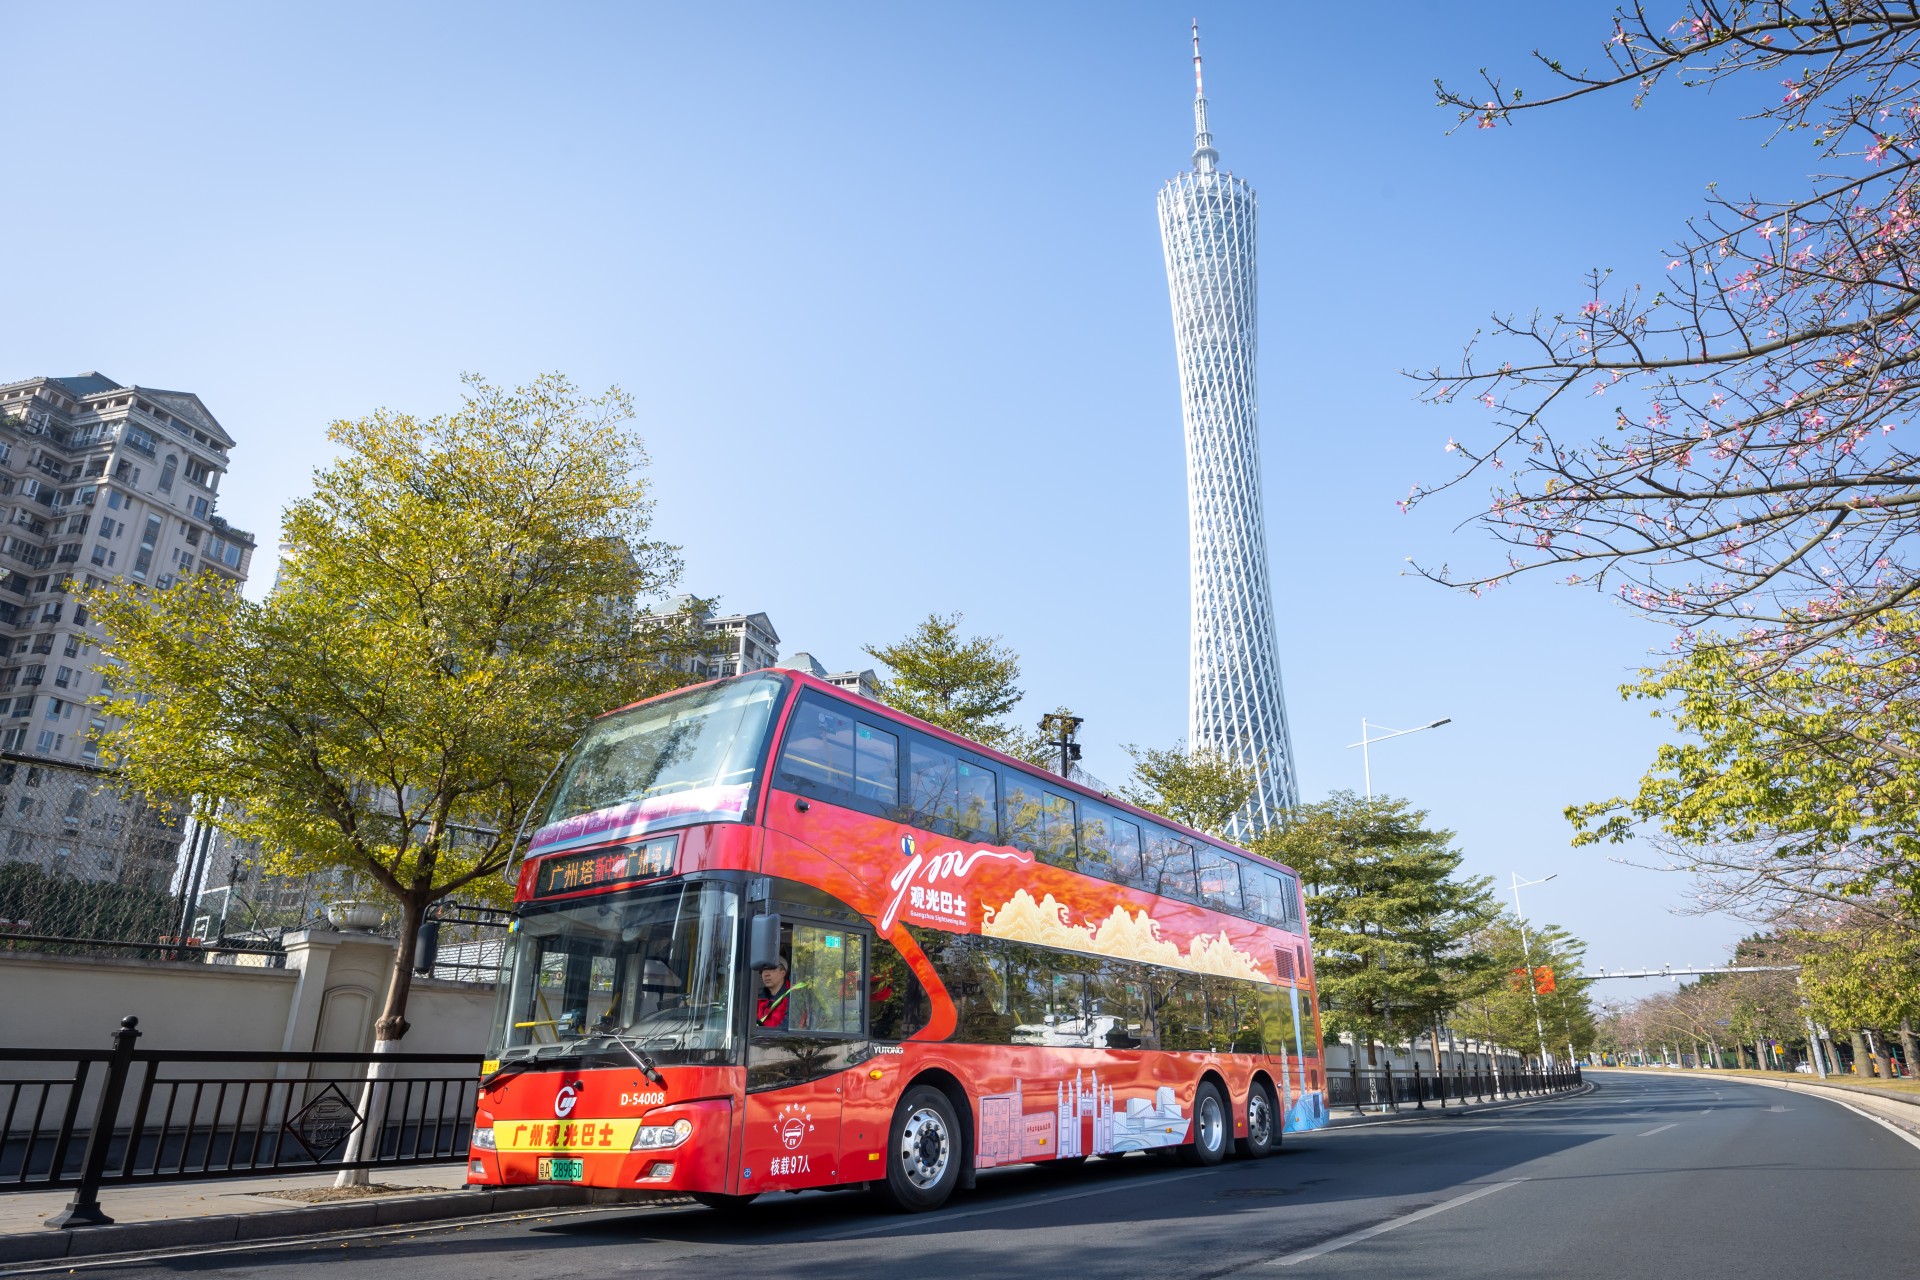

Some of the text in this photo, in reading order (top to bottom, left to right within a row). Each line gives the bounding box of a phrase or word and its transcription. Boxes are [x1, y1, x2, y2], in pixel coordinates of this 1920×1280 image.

[910, 885, 967, 917] 观光巴士
[910, 910, 935, 920] Guangzhou
[873, 1046, 904, 1054] YUTONG
[620, 1092, 665, 1106] D-54008
[512, 1123, 614, 1147] 广州观光巴士
[789, 1138, 797, 1146] EV
[770, 1154, 811, 1176] 核载97人
